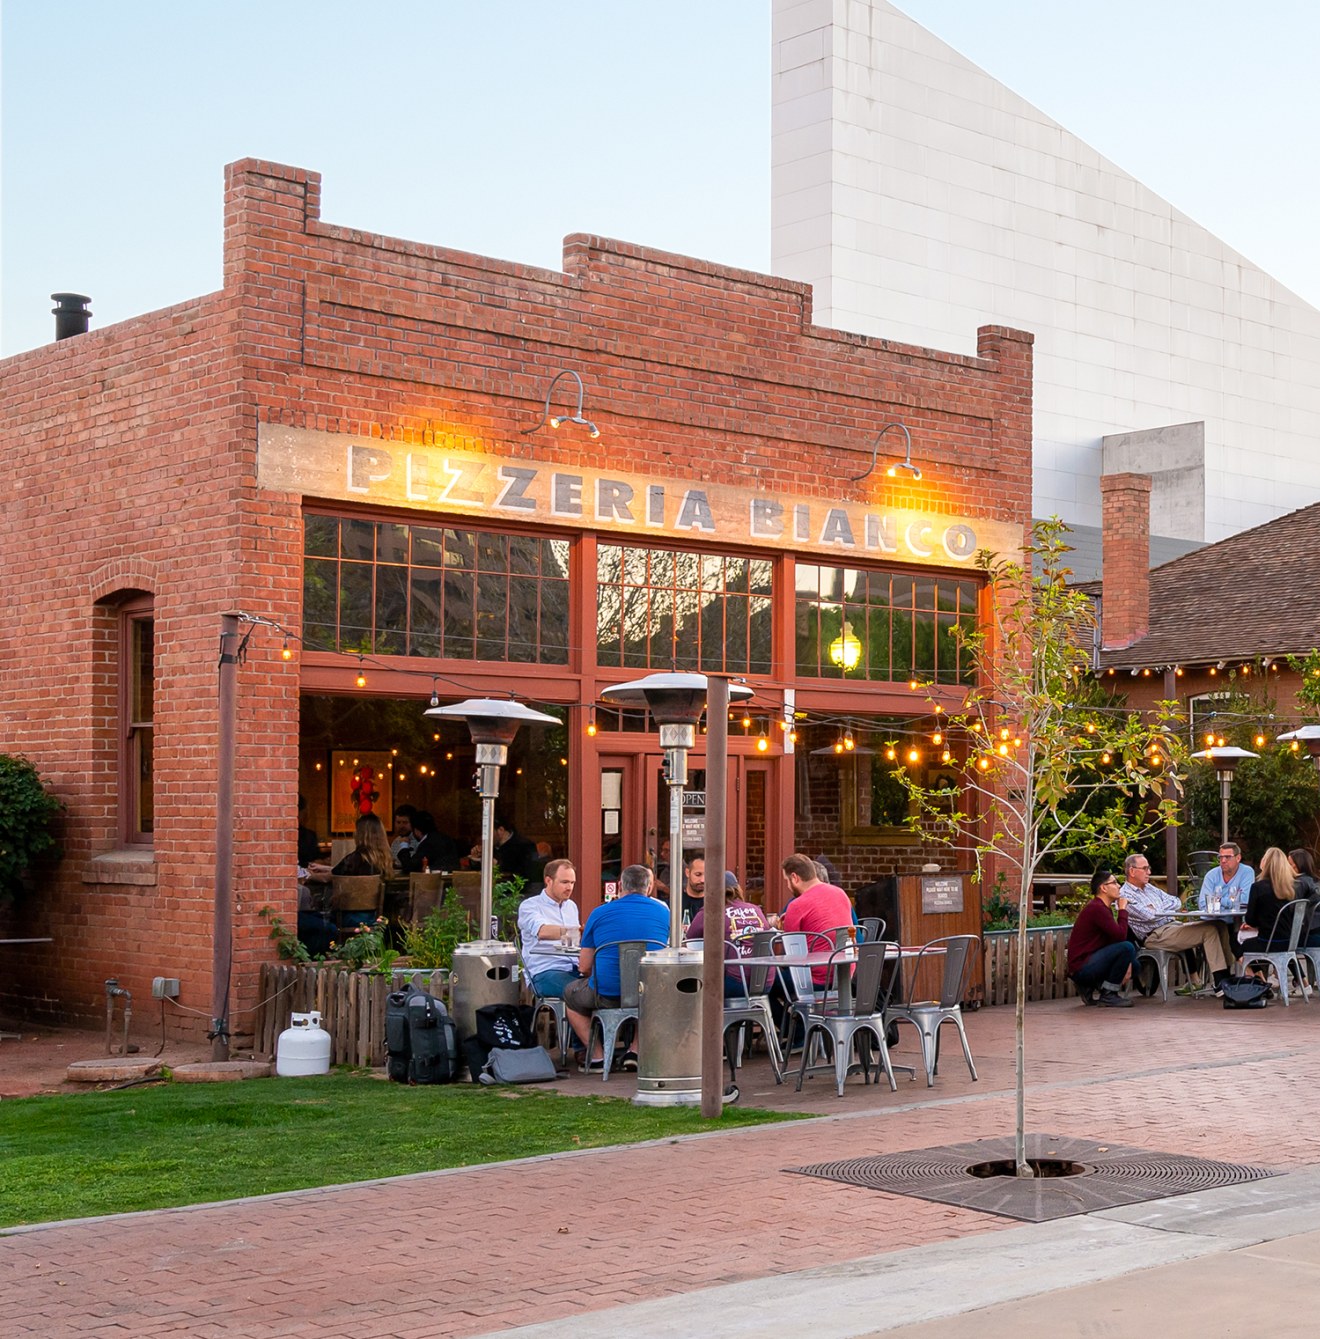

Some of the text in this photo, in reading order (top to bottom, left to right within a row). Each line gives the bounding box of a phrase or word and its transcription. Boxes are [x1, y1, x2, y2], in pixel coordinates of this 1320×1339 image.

[347, 445, 977, 561] PIZZERIA BIANCO
[726, 907, 758, 919] Enjoy
